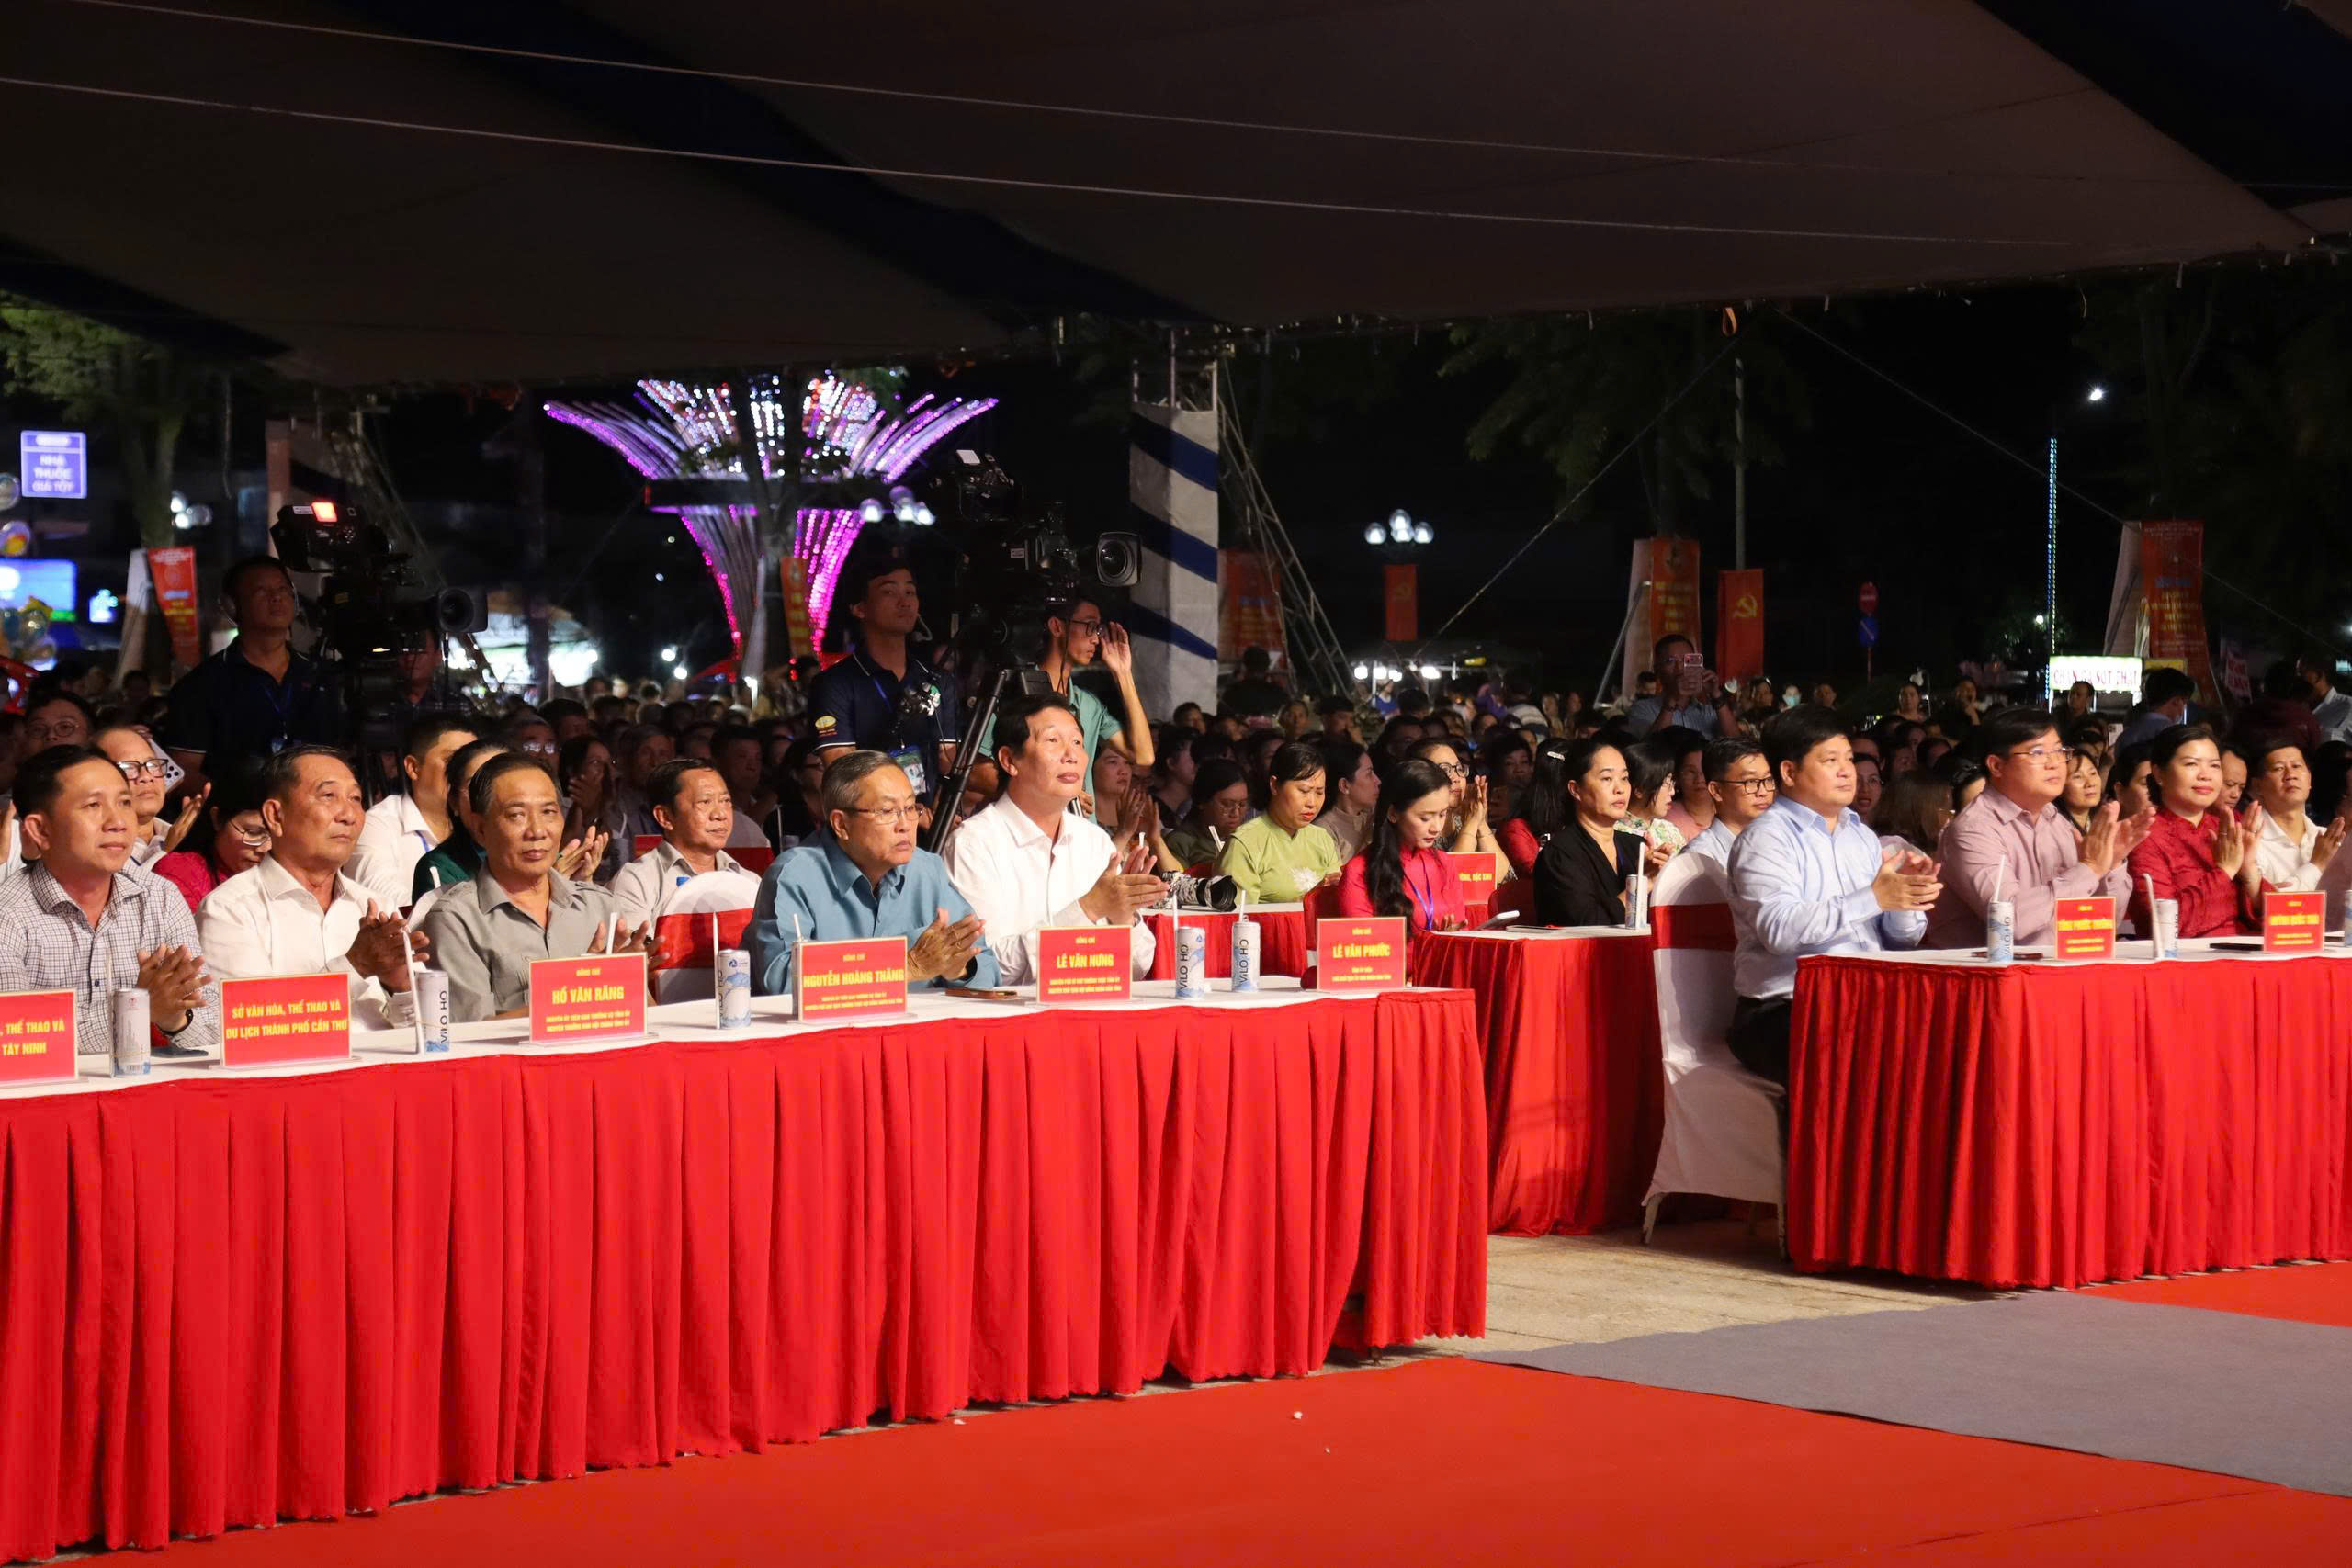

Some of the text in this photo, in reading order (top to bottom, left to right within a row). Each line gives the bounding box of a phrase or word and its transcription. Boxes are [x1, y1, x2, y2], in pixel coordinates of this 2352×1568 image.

[1332, 943, 1342, 958] LÊ
[1057, 953, 1068, 969] LÊ
[1069, 953, 1087, 968] VĂN
[803, 970, 840, 987] NGUYỄN
[842, 970, 873, 986] HOÀNG
[570, 986, 592, 1003] VĂN
[232, 1003, 244, 1019] SỞ
[246, 1004, 264, 1017] VĂN
[306, 1001, 328, 1014] THAO
[330, 999, 341, 1011] VÀ
[26, 1021, 50, 1033] THAO
[52, 1018, 65, 1032] VÀ
[226, 1028, 238, 1039] DU
[240, 1025, 259, 1040] LỊCH
[261, 1022, 290, 1036] THÀNH
[292, 1019, 310, 1033] PHỐ
[2, 1042, 47, 1055] TÂY NINH
